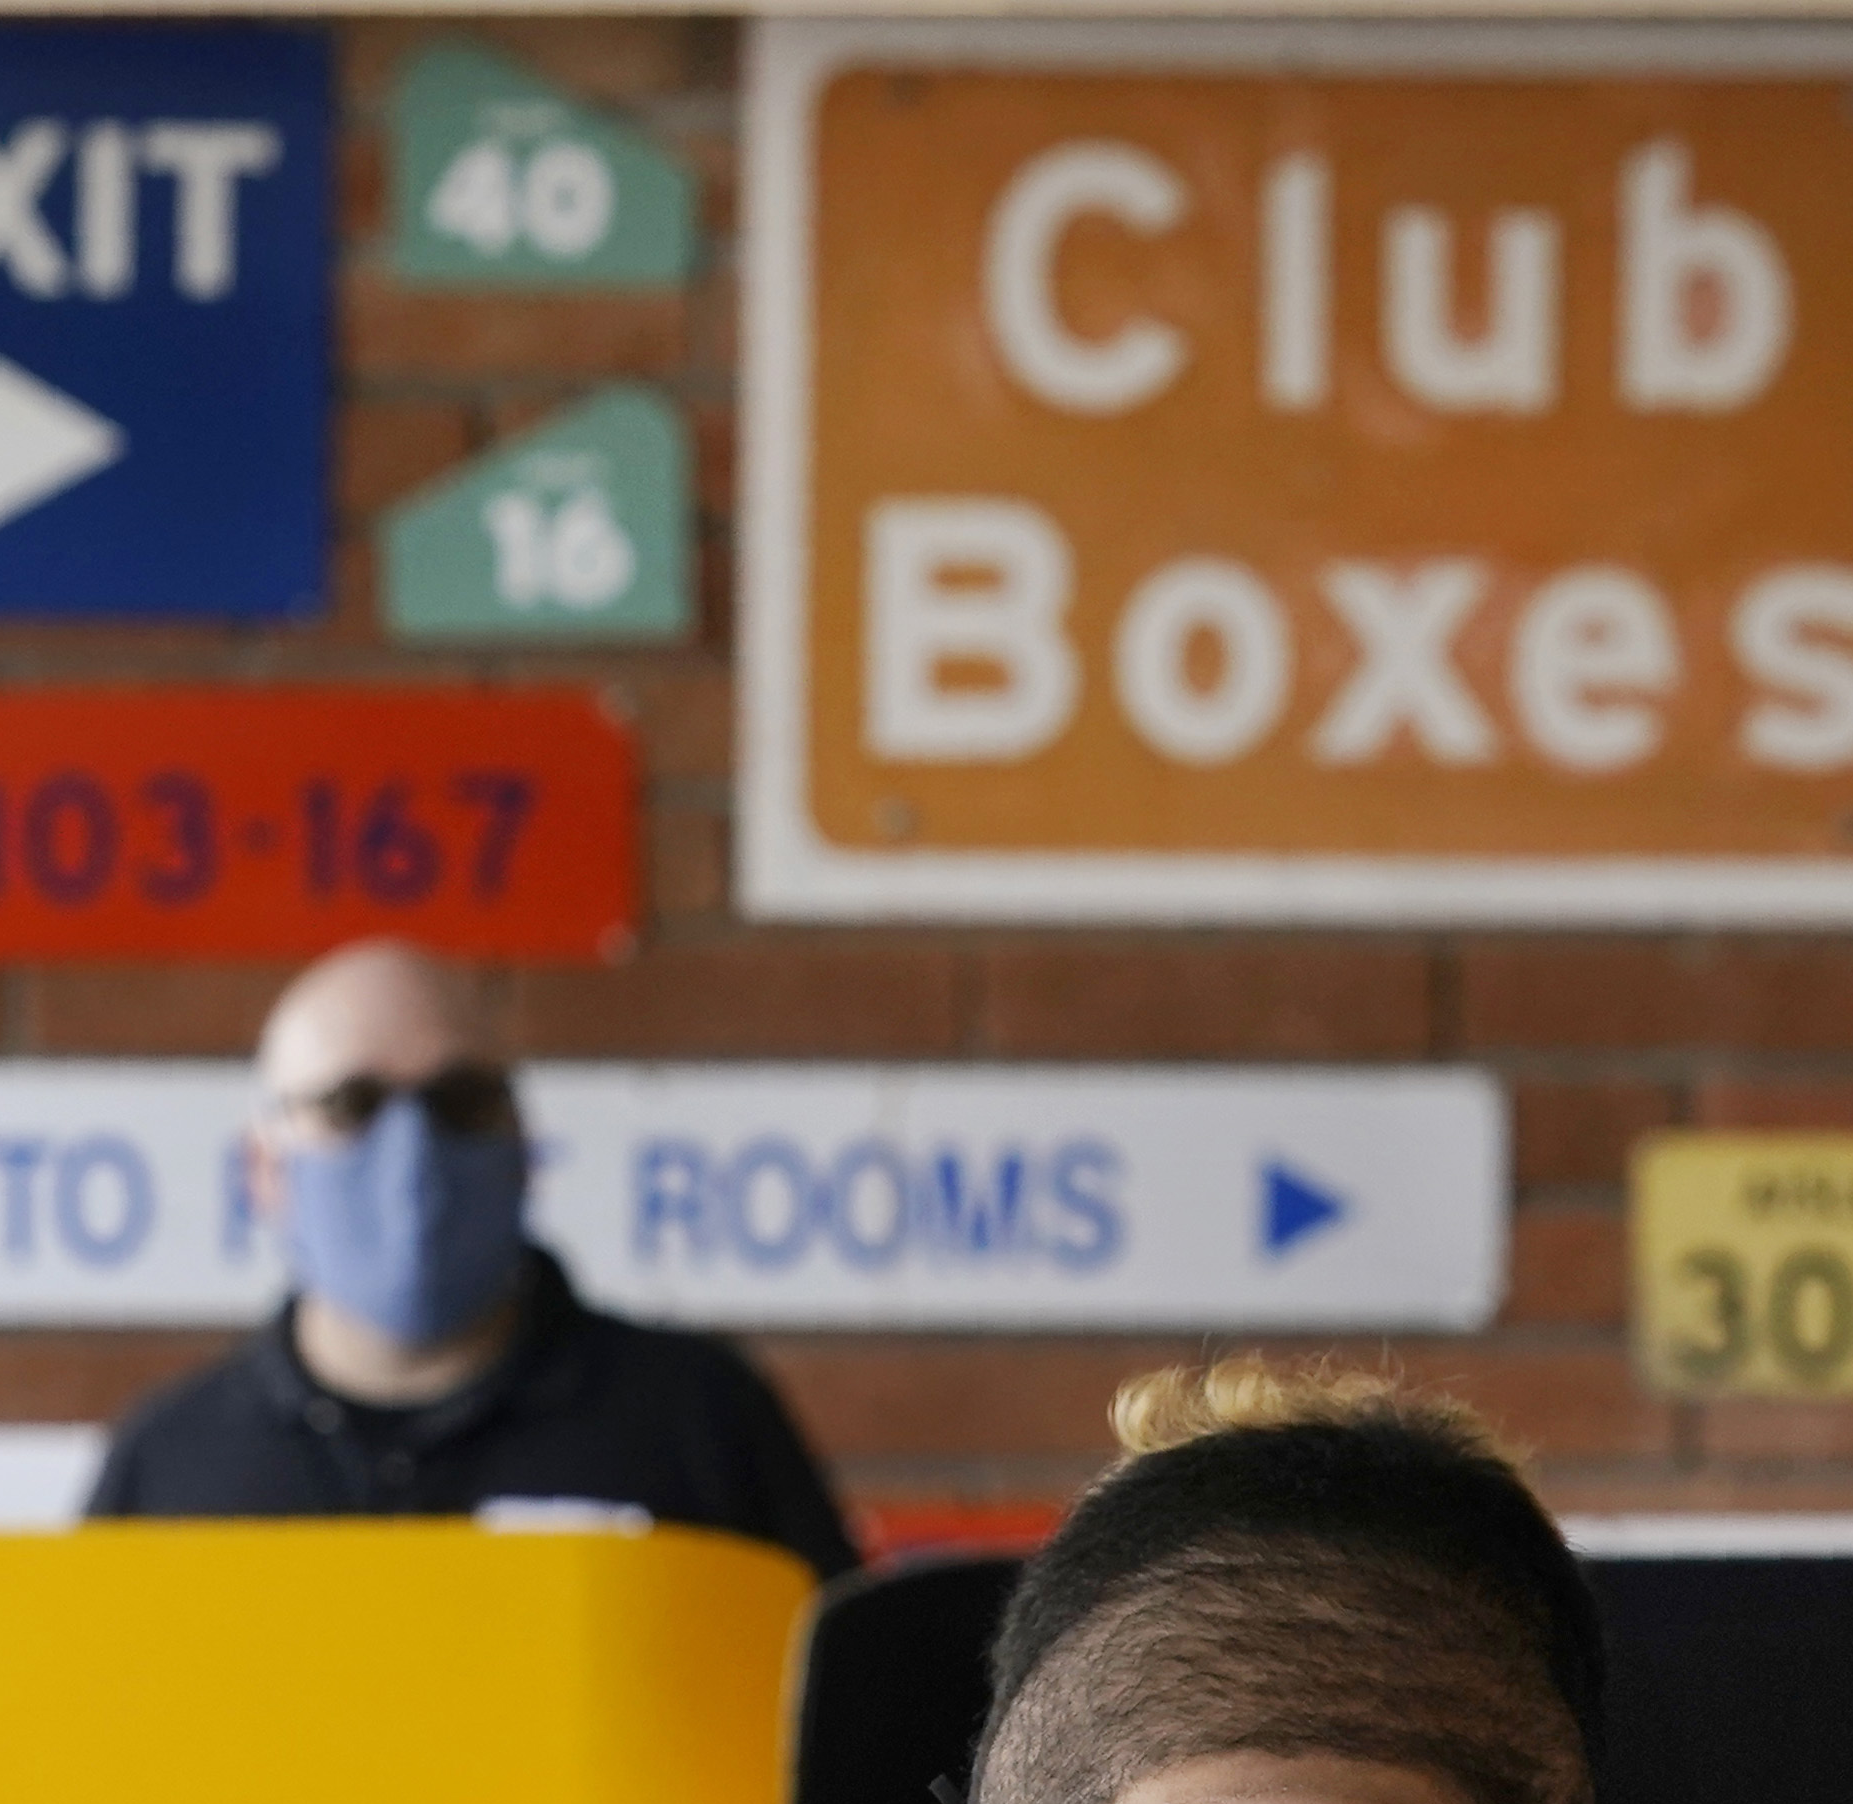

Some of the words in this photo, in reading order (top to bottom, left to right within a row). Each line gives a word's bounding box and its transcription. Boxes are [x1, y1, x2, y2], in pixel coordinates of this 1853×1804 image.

[428, 137, 614, 258] 40
[984, 140, 1791, 416] Club
[486, 489, 635, 608] 16
[631, 1137, 1121, 1271] ROOMS
